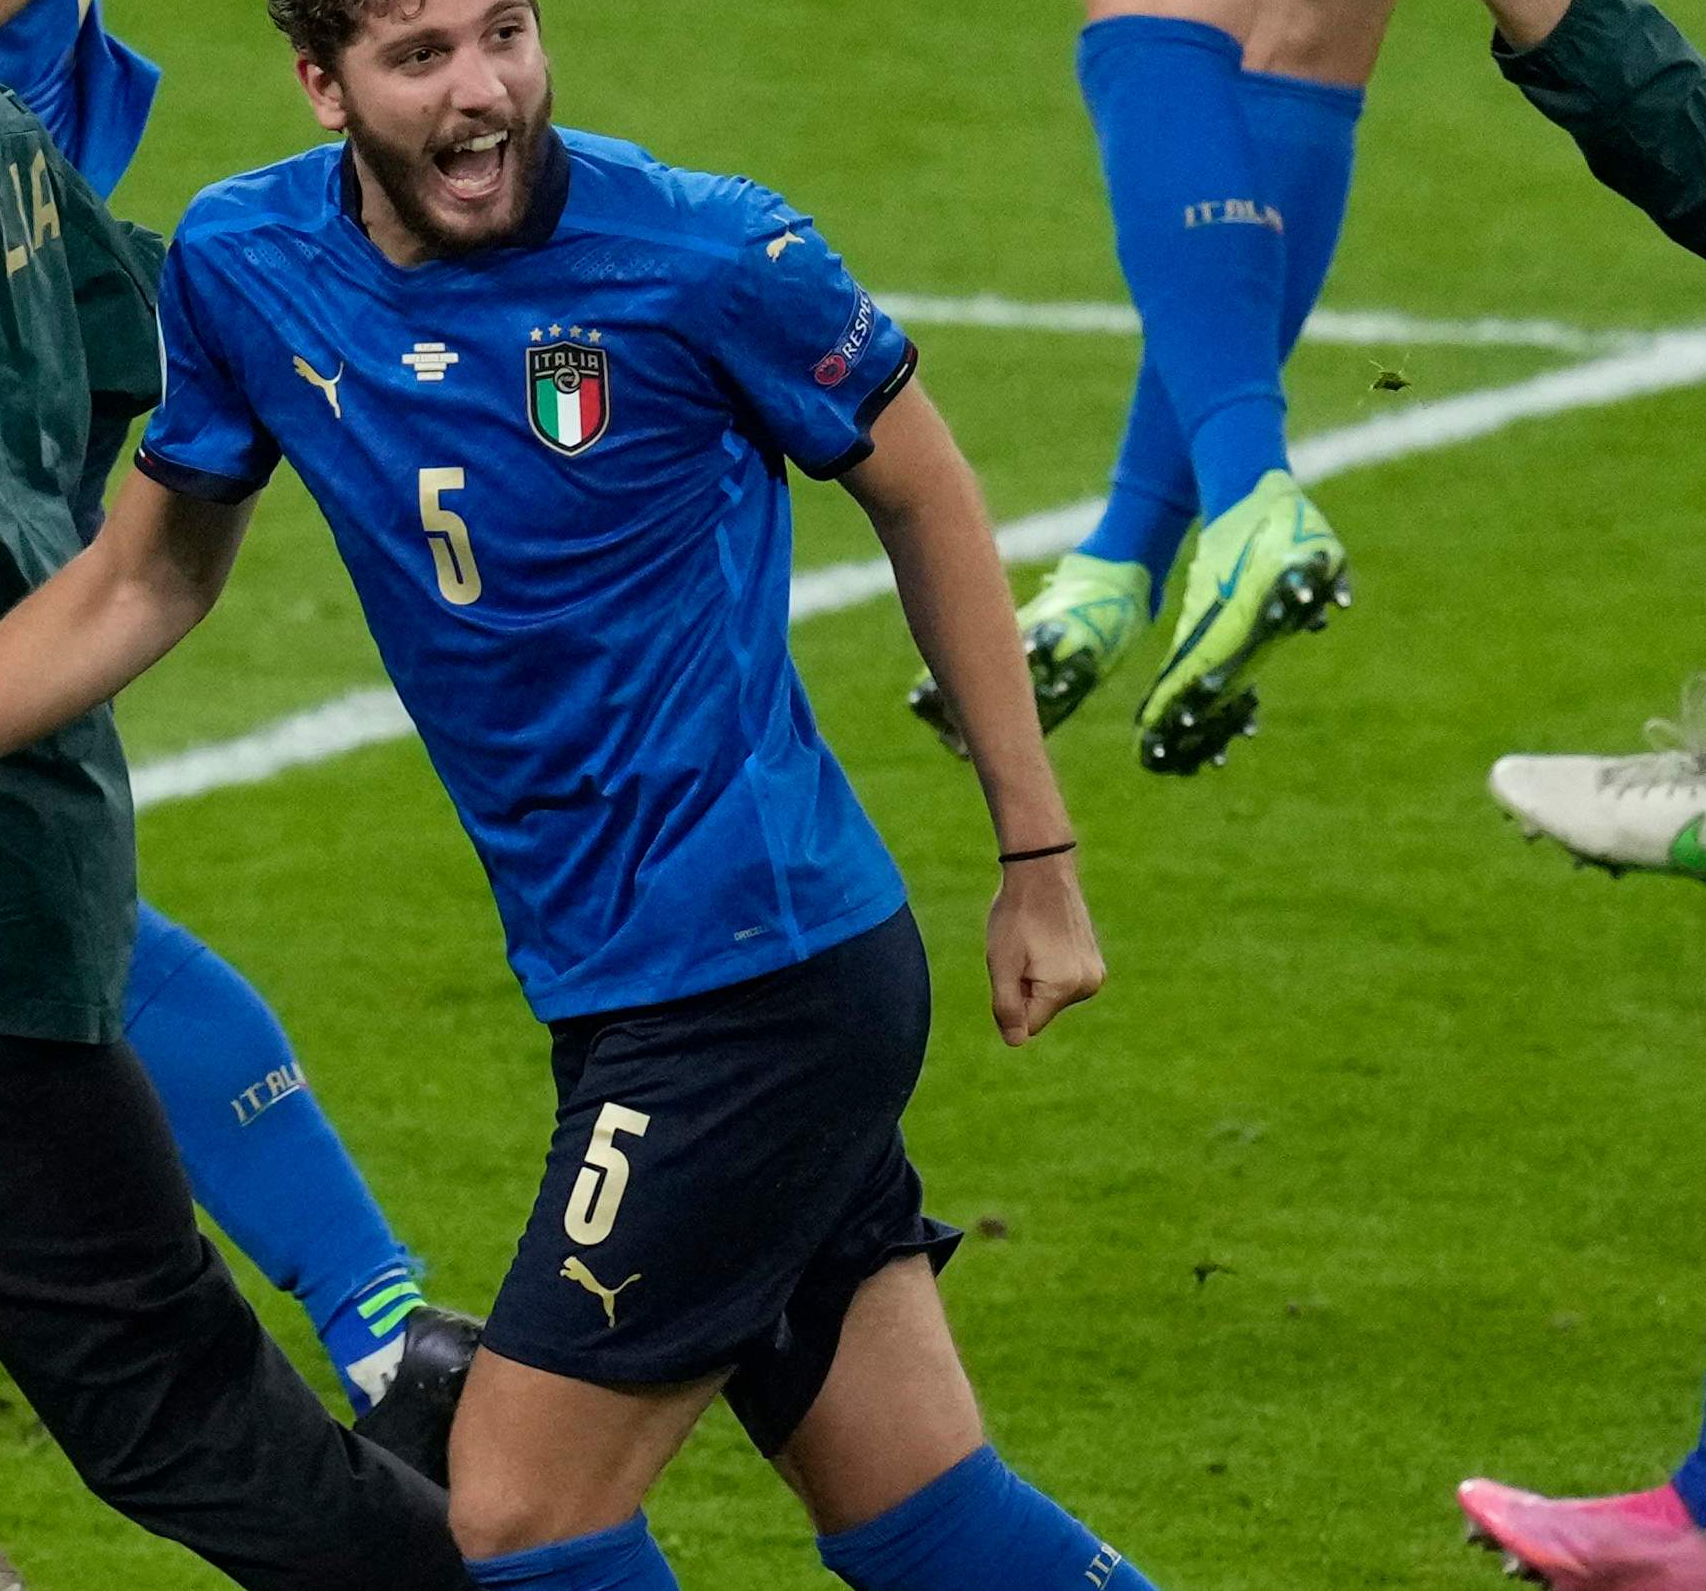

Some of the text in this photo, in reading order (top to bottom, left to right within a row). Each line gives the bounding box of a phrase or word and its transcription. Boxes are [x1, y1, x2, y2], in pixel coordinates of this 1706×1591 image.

[534, 351, 600, 371] ITALIA
[418, 466, 483, 606] 5
[564, 1100, 651, 1246] 5
